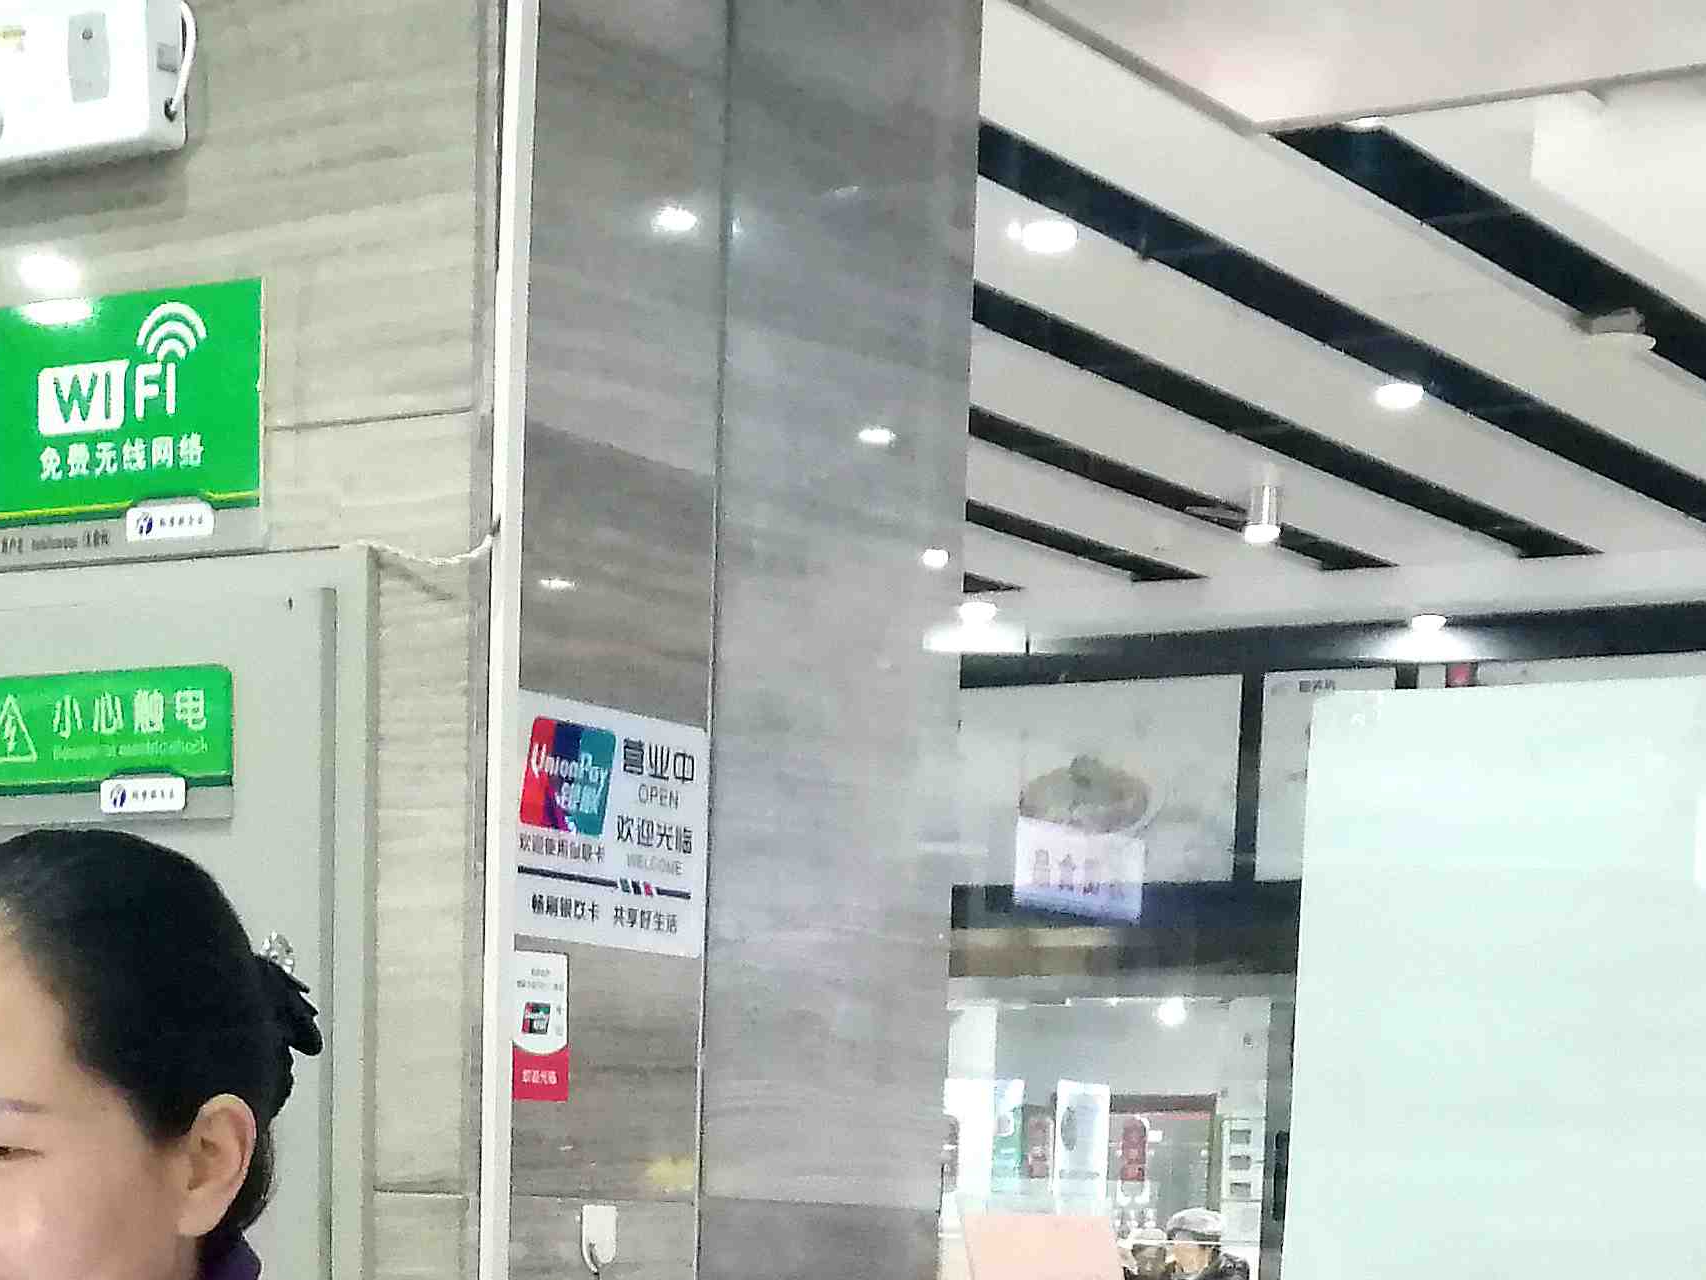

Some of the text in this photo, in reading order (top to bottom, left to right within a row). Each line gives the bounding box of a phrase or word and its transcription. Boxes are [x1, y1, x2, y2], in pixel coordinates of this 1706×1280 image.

[39, 432, 204, 480] 免费无线网络
[51, 688, 208, 739] 小心触电
[530, 744, 609, 787] UnionPay
[623, 736, 695, 783] 营业中
[637, 784, 679, 810] OPEN
[616, 814, 693, 855] 欢迎光临
[626, 853, 683, 876] WELCOME
[613, 905, 679, 935] 共享好生活
